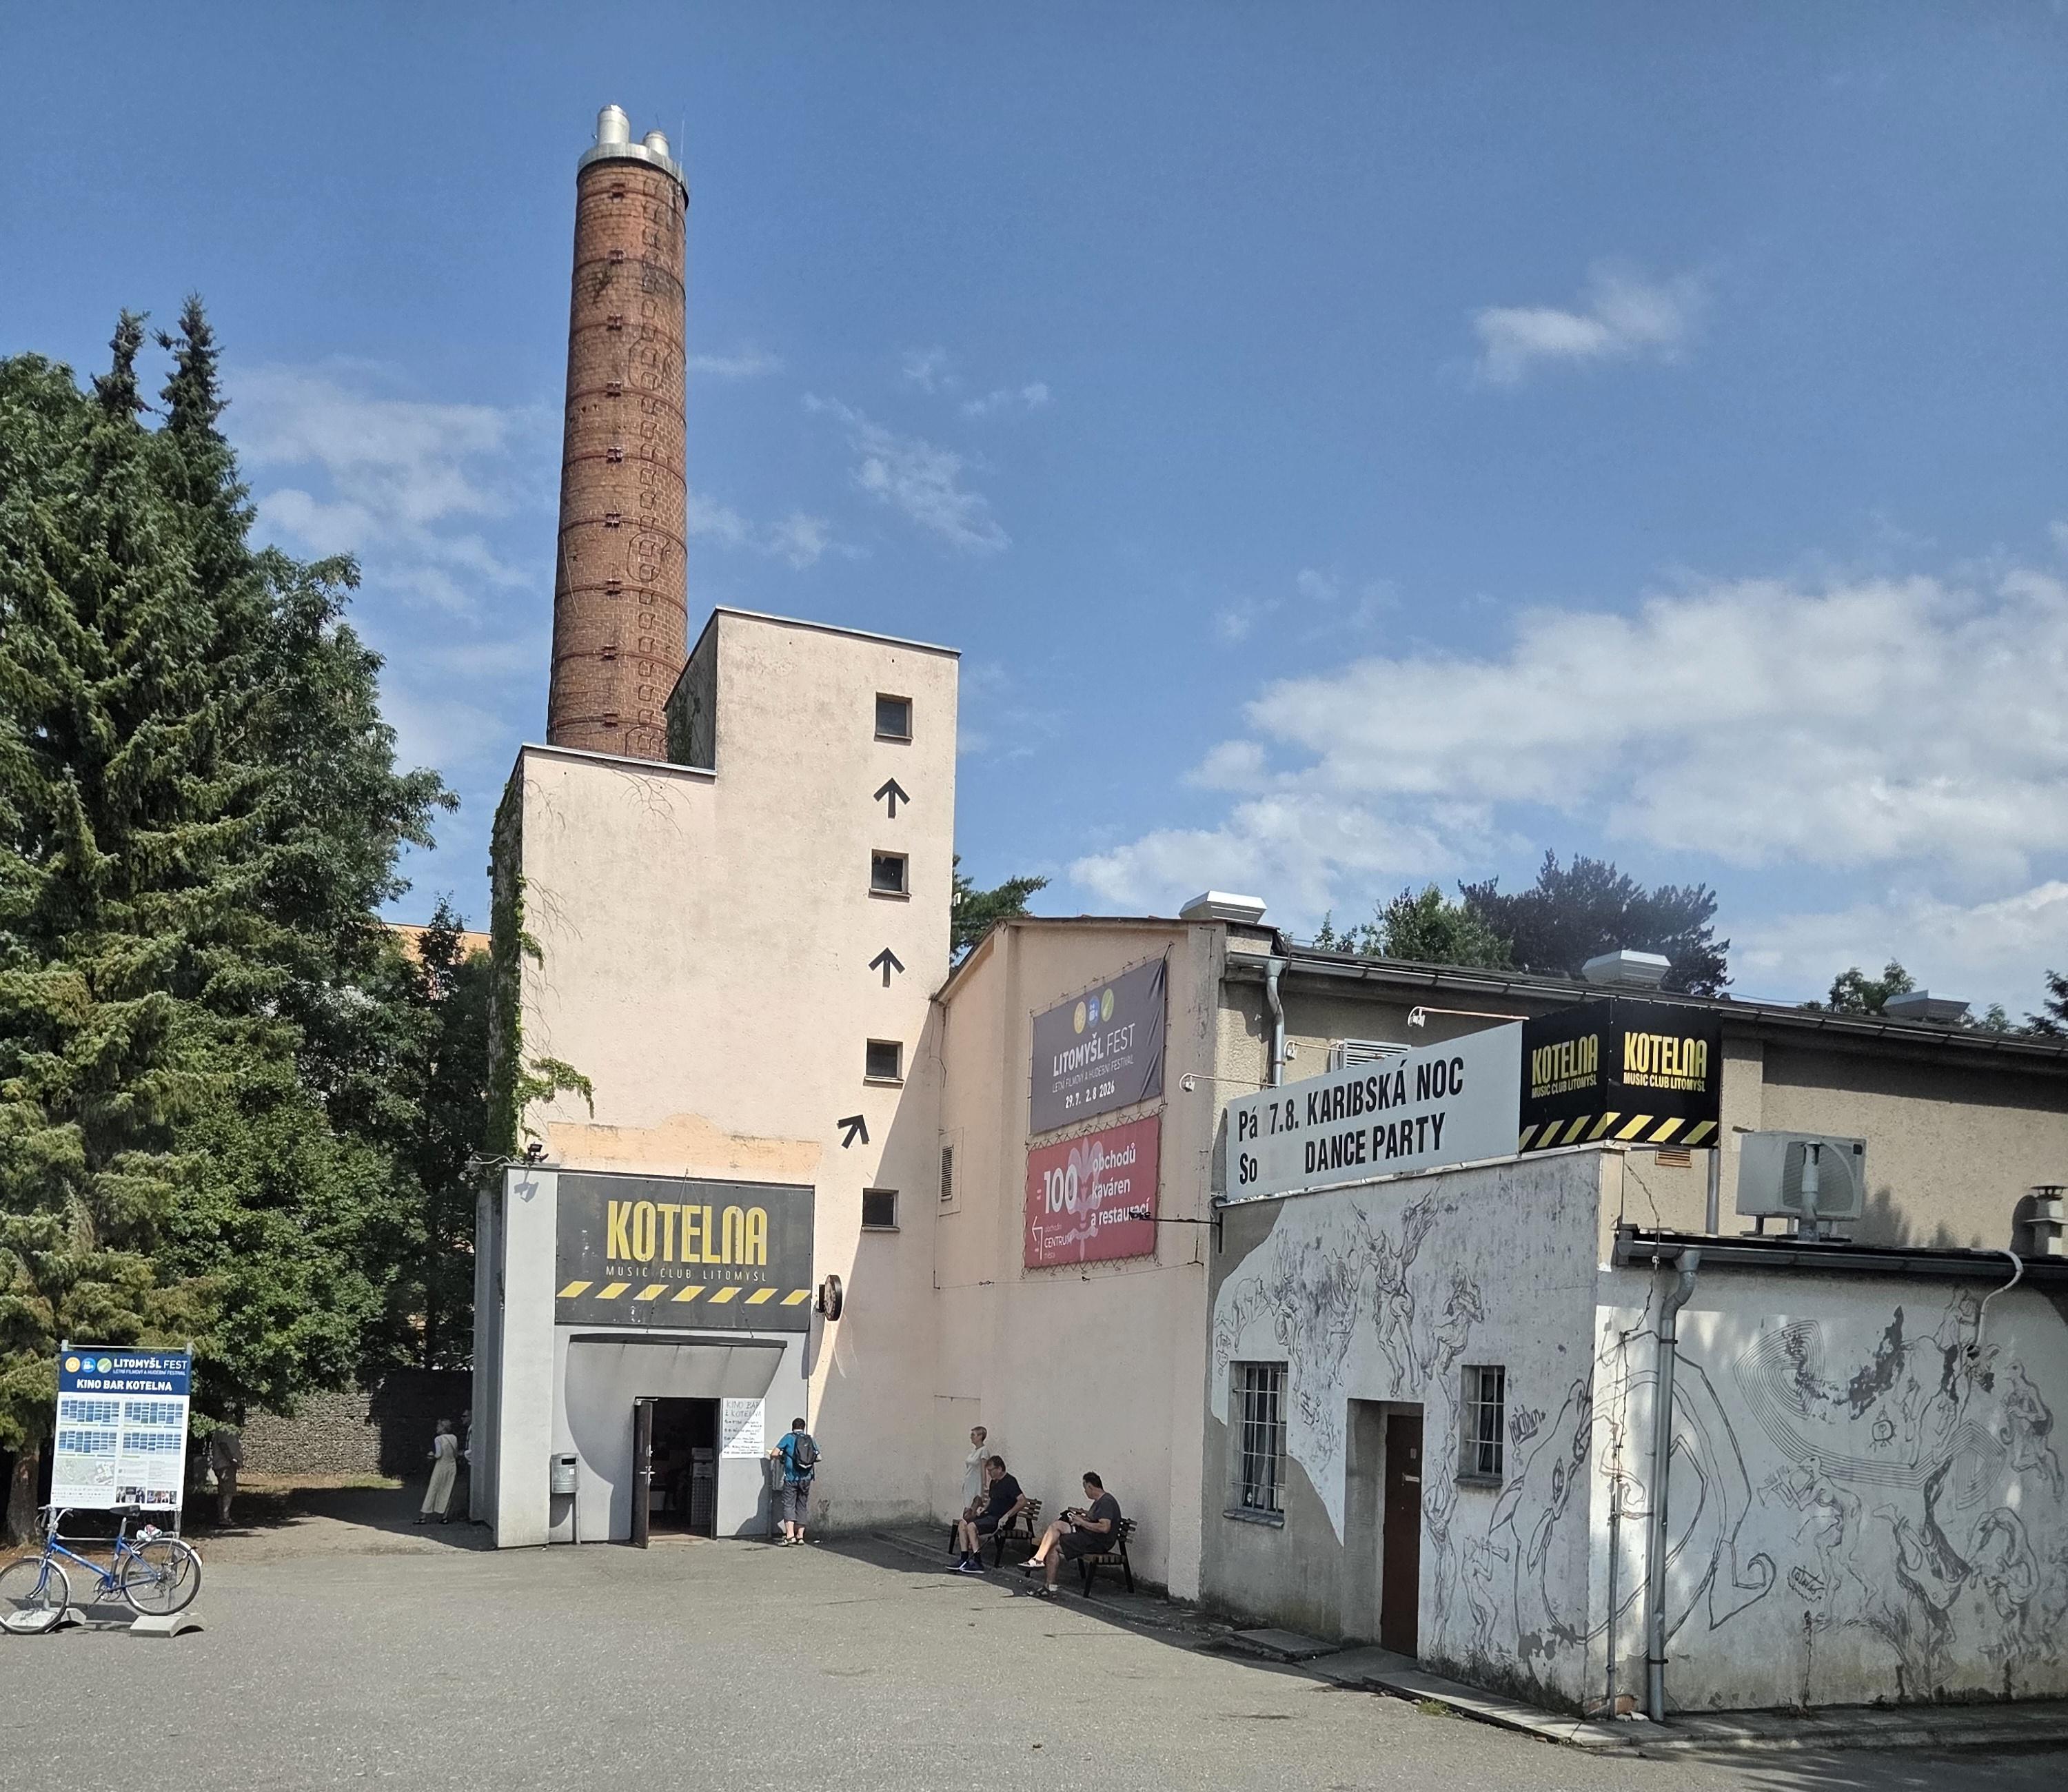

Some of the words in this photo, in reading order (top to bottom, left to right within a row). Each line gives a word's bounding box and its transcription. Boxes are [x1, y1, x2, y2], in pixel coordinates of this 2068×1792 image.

[1053, 1032, 1104, 1077] LITOMYŠL
[1106, 1023, 1135, 1056] FEST
[1532, 1034, 1599, 1086] KOTELNA
[1623, 1031, 1707, 1079] KOTELNA
[1099, 1080, 1115, 1098] 2026
[1532, 1083, 1551, 1099] MUSIC
[1551, 1079, 1567, 1094] CLUB
[1623, 1072, 1649, 1086] MUSIC
[1650, 1075, 1670, 1088] CLUB
[1239, 1106, 1258, 1142] Pá
[1269, 1099, 1299, 1134] 7.8.
[1307, 1059, 1407, 1126] KARIBSKÁ
[1416, 1057, 1464, 1102] NOC
[1092, 1142, 1136, 1172] obchodů
[1239, 1152, 1257, 1185] So
[1305, 1129, 1366, 1174] DANCE
[1372, 1112, 1446, 1161] PARTY
[1044, 1163, 1078, 1214] 100
[1091, 1177, 1131, 1199] kaváren
[607, 1199, 768, 1266] KOTELNA
[1091, 1213, 1096, 1226] a
[606, 1266, 648, 1277] MUSIC
[660, 1267, 692, 1279] CLUB
[114, 1357, 162, 1369] LITOMYŠL
[163, 1360, 187, 1370] FEST
[77, 1378, 101, 1389] KINO
[103, 1380, 124, 1390] BAR
[125, 1381, 172, 1391] KOTELNA
